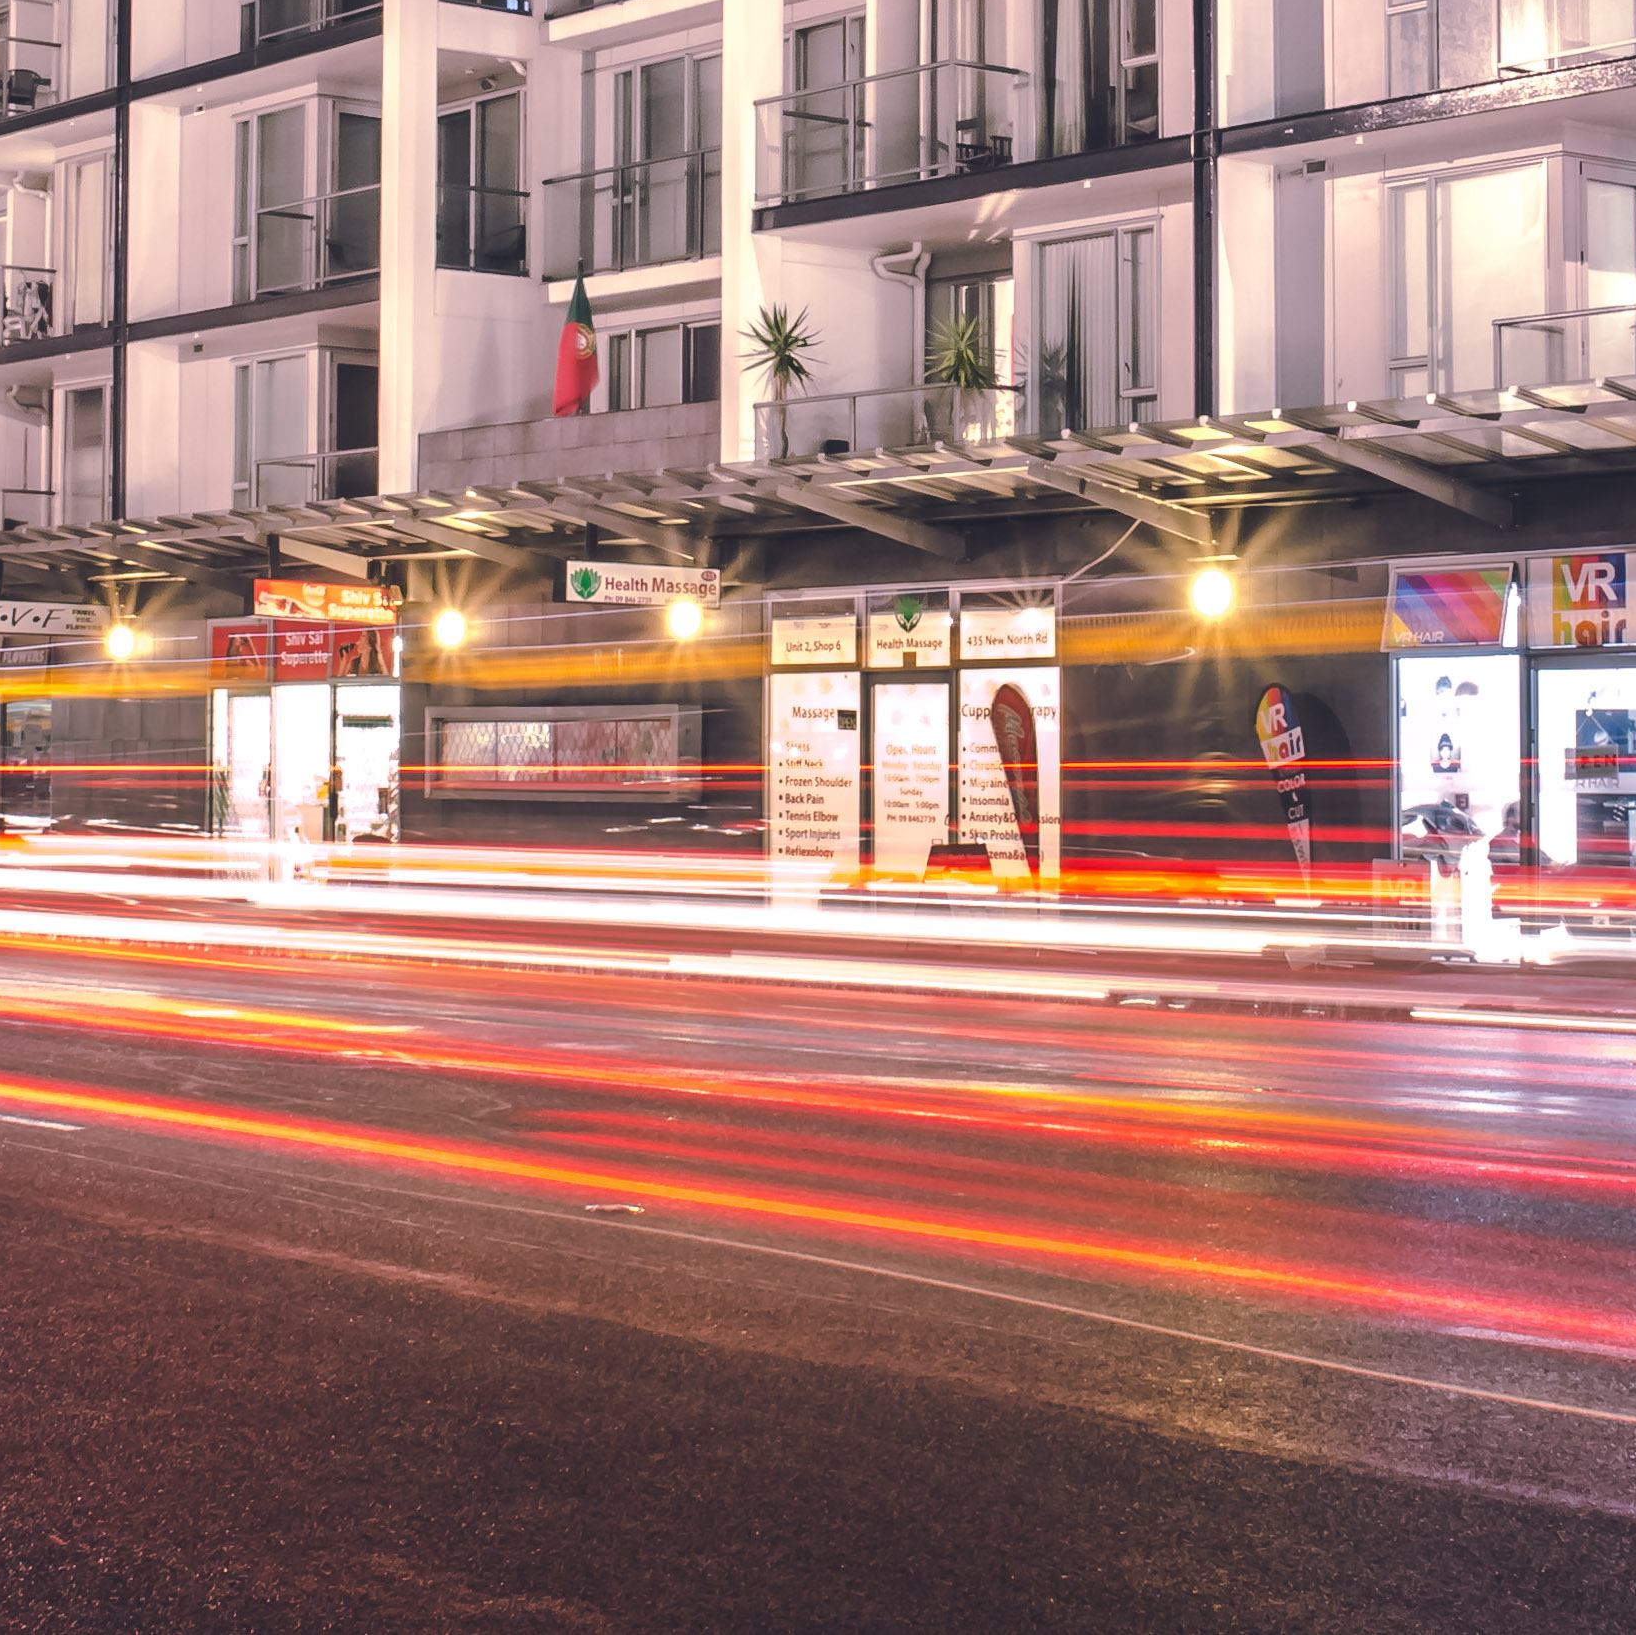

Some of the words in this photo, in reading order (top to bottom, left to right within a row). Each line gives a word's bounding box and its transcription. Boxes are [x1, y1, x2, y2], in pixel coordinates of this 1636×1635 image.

[604, 576, 648, 592] Health
[652, 577, 716, 599] Massage
[1561, 562, 1618, 602] VR
[341, 589, 372, 605] Shiv
[327, 603, 394, 621] Superette
[1553, 610, 1627, 646] hair
[285, 632, 307, 647] Shiv
[967, 635, 983, 646] 435
[985, 635, 1004, 645] New
[1007, 633, 1034, 645] North
[1036, 632, 1048, 644] Rd
[1394, 631, 1413, 643] VR
[1414, 630, 1445, 643] HAIR
[786, 641, 803, 652] Unit
[813, 640, 835, 652] Shop
[836, 640, 841, 651] 6
[876, 638, 904, 650] Health
[906, 637, 943, 651] Massage
[2, 650, 46, 664] FLOWERS
[280, 650, 329, 668] Superette
[792, 706, 835, 722] Massage
[962, 704, 991, 721] Cupp
[1260, 702, 1288, 734] VR
[969, 742, 998, 753] Comm
[1267, 733, 1302, 762] hair
[785, 776, 813, 787] Frozen
[815, 777, 853, 788] Shoulder
[1276, 773, 1306, 793] COLOR
[1588, 777, 1620, 789] HAIR
[785, 793, 804, 804] Back
[806, 794, 824, 804] Pain
[969, 795, 1009, 806] Insomnia
[785, 810, 812, 821] Tennis
[813, 811, 838, 822] Elbow
[1288, 804, 1304, 820] CUT
[785, 828, 808, 840] Sport
[809, 828, 840, 841] Injuries
[969, 829, 988, 841] Skin
[990, 829, 1022, 840] Proble
[785, 846, 834, 859] Reflexology
